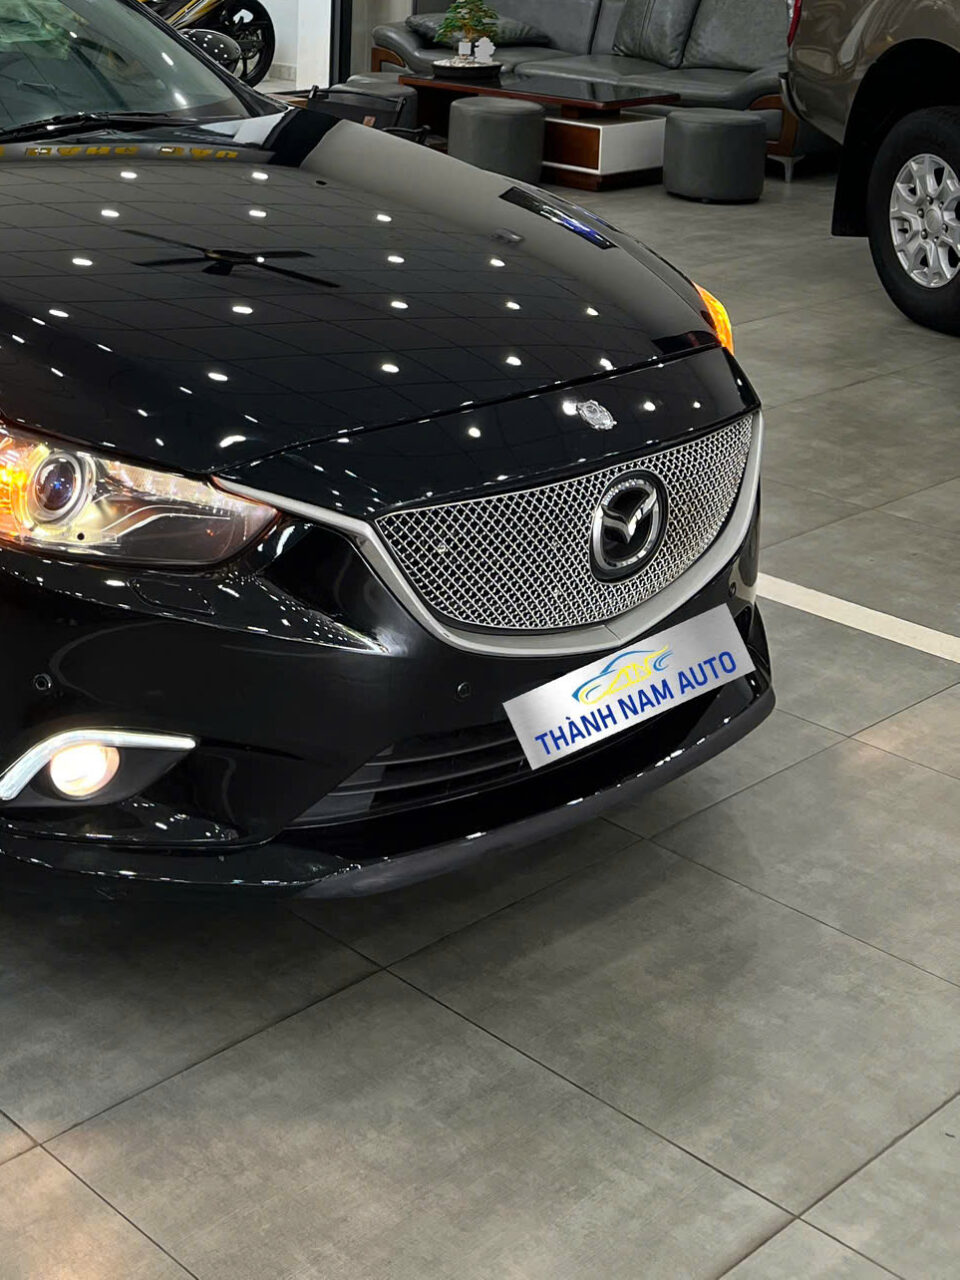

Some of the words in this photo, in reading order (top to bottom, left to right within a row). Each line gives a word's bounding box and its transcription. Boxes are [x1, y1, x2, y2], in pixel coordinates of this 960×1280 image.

[534, 704, 617, 756] THÀNH
[617, 679, 674, 720] NAM
[678, 651, 737, 696] AUTO
